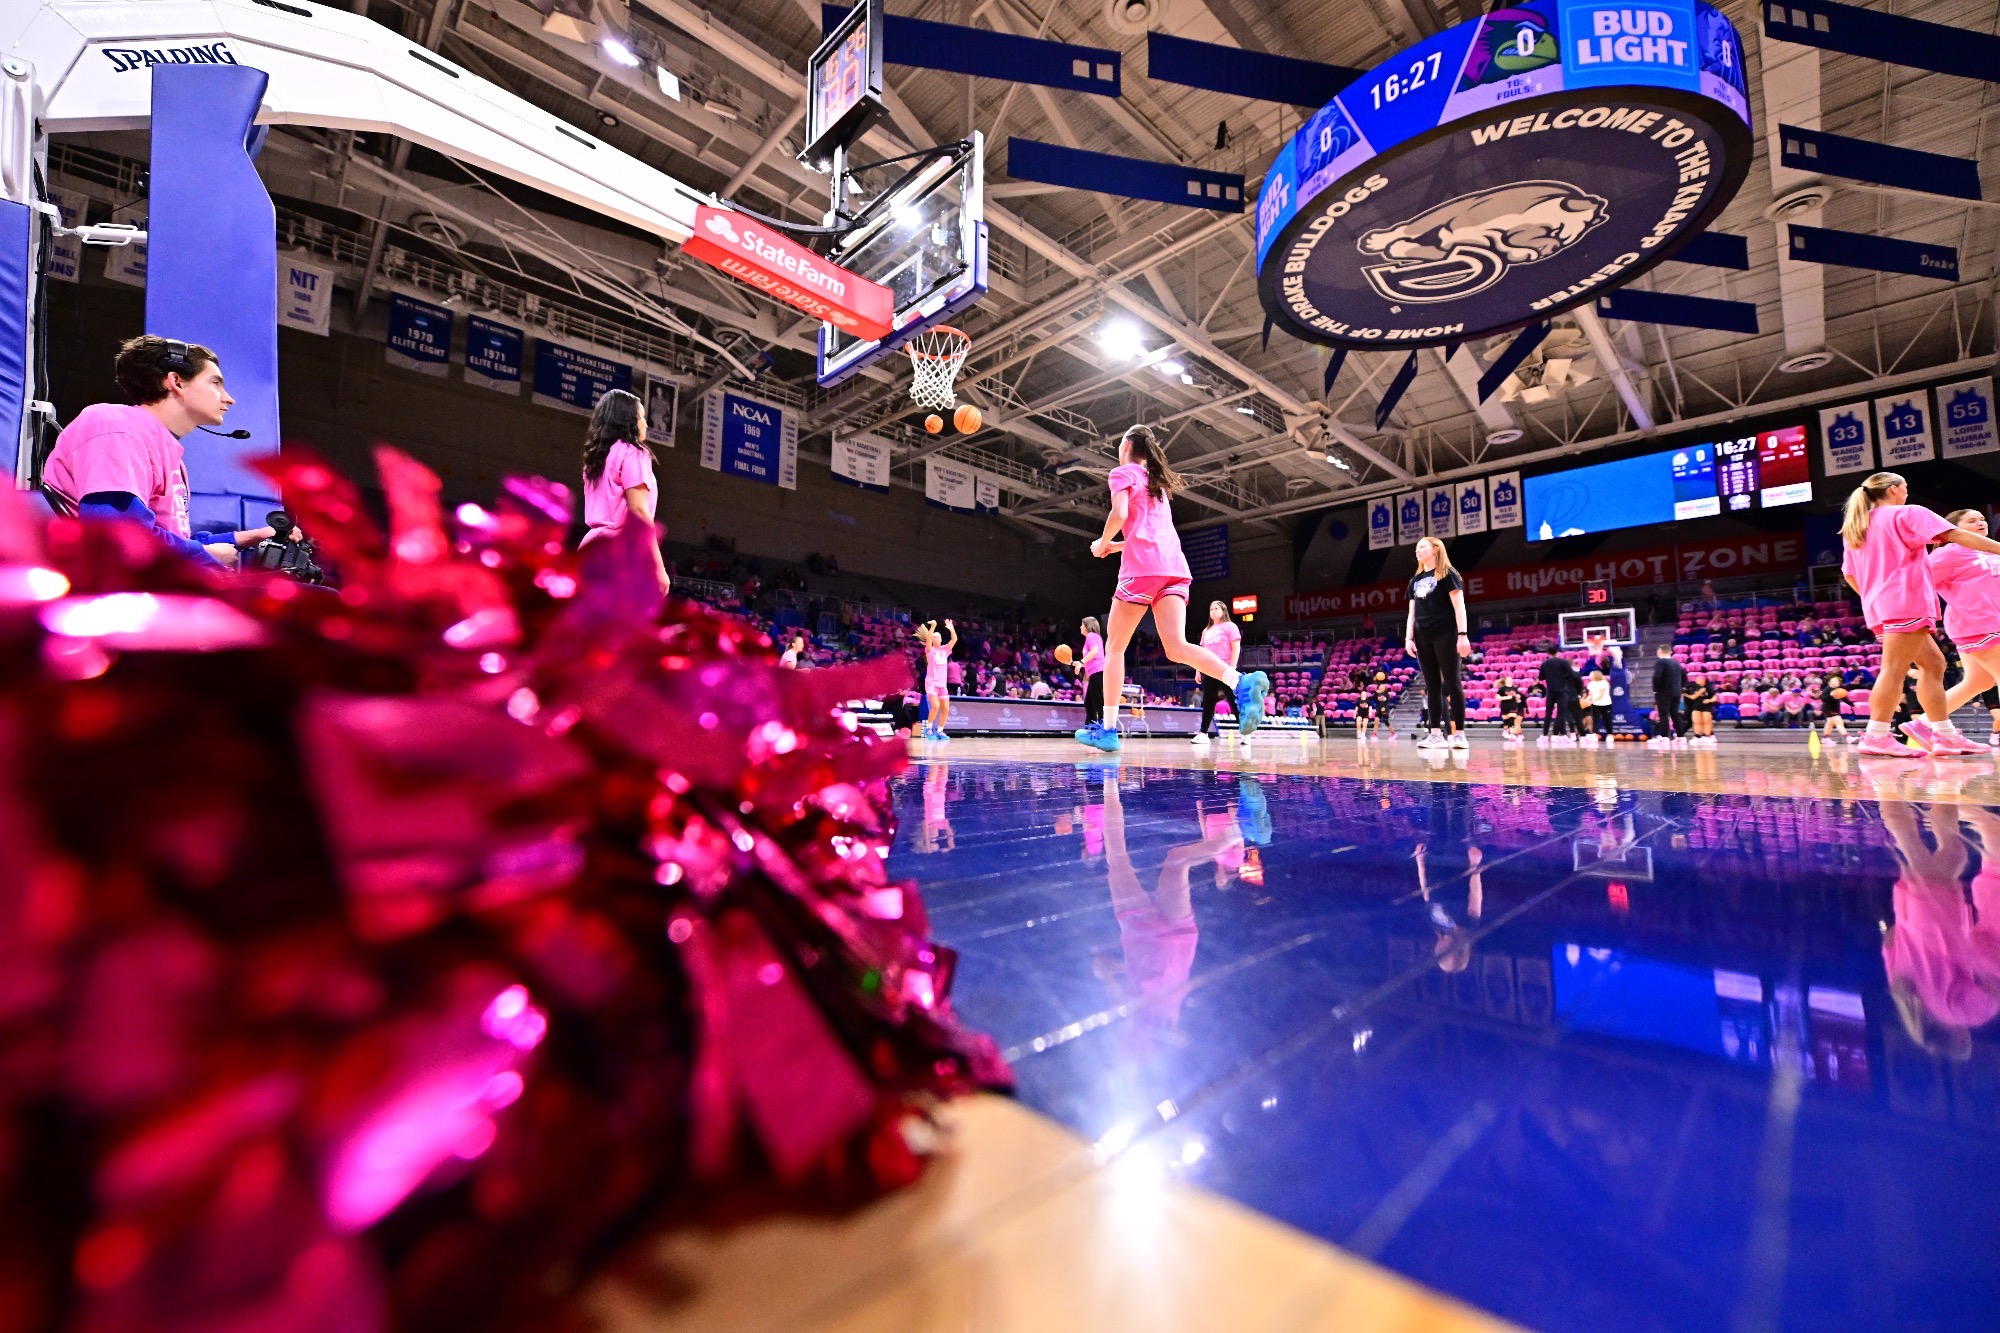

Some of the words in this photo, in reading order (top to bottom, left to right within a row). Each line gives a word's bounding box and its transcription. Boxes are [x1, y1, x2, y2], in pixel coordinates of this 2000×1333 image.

[1593, 9, 1674, 37] BUD
[1516, 28, 1534, 56] 0
[1577, 35, 1688, 67] LIGHT
[102, 42, 239, 73] SPALDING
[1370, 51, 1442, 111] 16:27
[1497, 86, 1534, 101] FOULS:
[1470, 106, 1664, 146] WELCOME
[1650, 118, 1695, 149] TO
[1320, 126, 1332, 153] 0
[1674, 139, 1711, 184] THE
[1639, 180, 1707, 249] KNAPP
[1284, 174, 1389, 274] BULLDOGS
[1920, 254, 1955, 269] Drake
[289, 268, 319, 291] NIT
[1529, 252, 1640, 311] CENTER
[1282, 274, 1320, 320] DRAKE
[1310, 315, 1350, 335] THE
[1348, 327, 1383, 340] OF
[1384, 322, 1464, 340] HOME
[408, 327, 433, 343] 1970
[392, 335, 416, 349] ELITE
[419, 343, 445, 357] EIGHT
[483, 348, 505, 362] 1971
[469, 355, 491, 369] ELITE
[494, 362, 517, 375] EIGHT
[553, 347, 574, 360] MEN'S
[576, 354, 616, 373] BASKETBALL
[566, 363, 613, 382] APPEARANCES
[733, 402, 771, 426] NCAA
[1953, 401, 1981, 419] 55
[744, 424, 761, 438] 1969
[1891, 414, 1916, 431] 13
[1954, 425, 1984, 436] LORRI
[1767, 436, 1778, 449] 0
[1834, 425, 1859, 442] 33
[1896, 436, 1916, 445] JAN
[1949, 432, 1992, 445] BAUMAN
[1696, 449, 1705, 462] 0
[1715, 436, 1756, 457] 16:27
[1831, 446, 1864, 457] WANDA
[1889, 443, 1926, 455] JENSEN
[1836, 454, 1860, 463] FORD
[734, 460, 751, 472] FINAL
[752, 464, 766, 477] FOUR
[1464, 497, 1478, 508] 30
[1497, 489, 1513, 502] 33
[1404, 507, 1418, 518] 15
[1433, 501, 1448, 512] 42
[1377, 513, 1384, 523] 5
[1595, 555, 1668, 582] HOT
[1683, 539, 1798, 572] ZONE
[1351, 587, 1400, 609] HOT
[1588, 589, 1606, 604] 30
